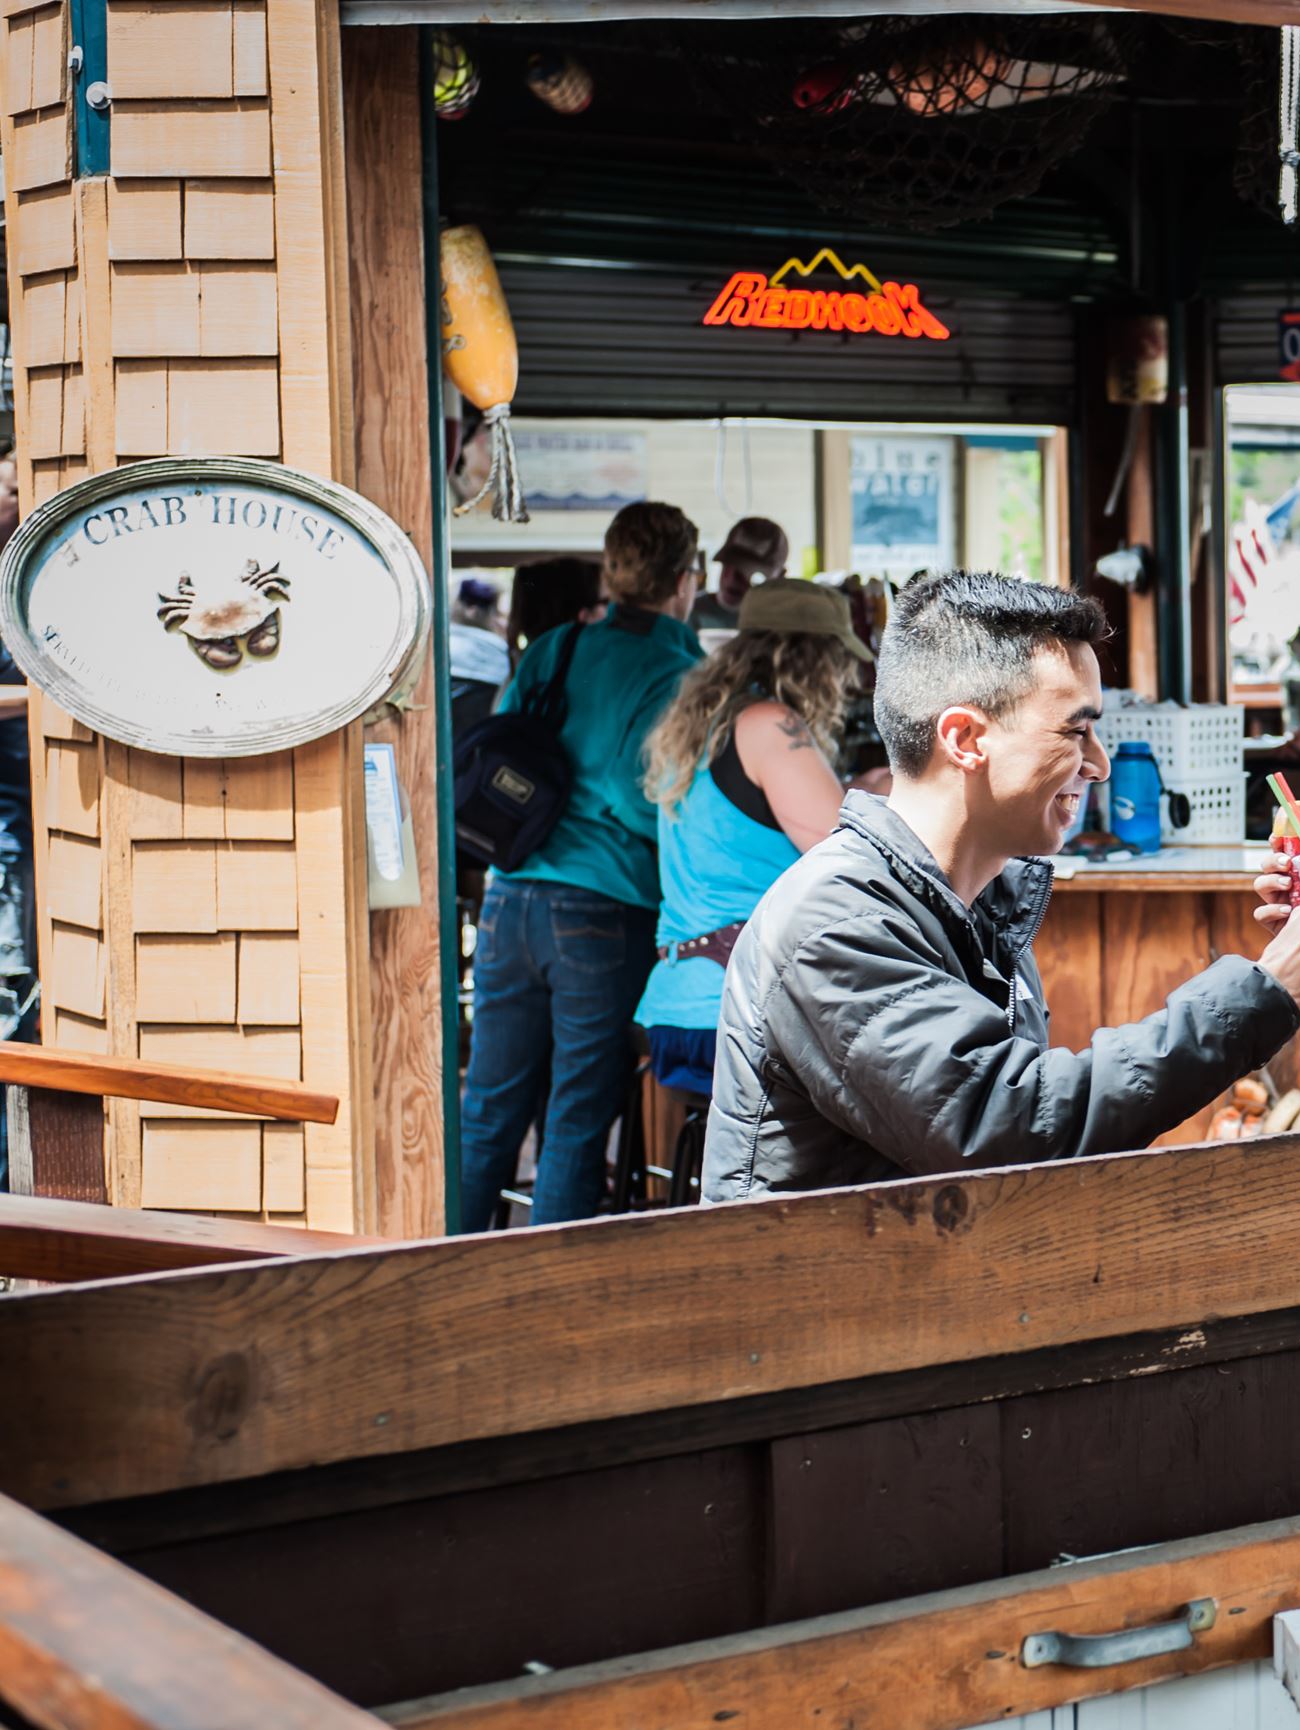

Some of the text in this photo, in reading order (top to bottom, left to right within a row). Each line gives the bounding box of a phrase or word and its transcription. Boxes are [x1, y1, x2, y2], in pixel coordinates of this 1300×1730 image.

[702, 271, 951, 340] REDHOOK
[83, 495, 345, 560] CRAB HOUSE
